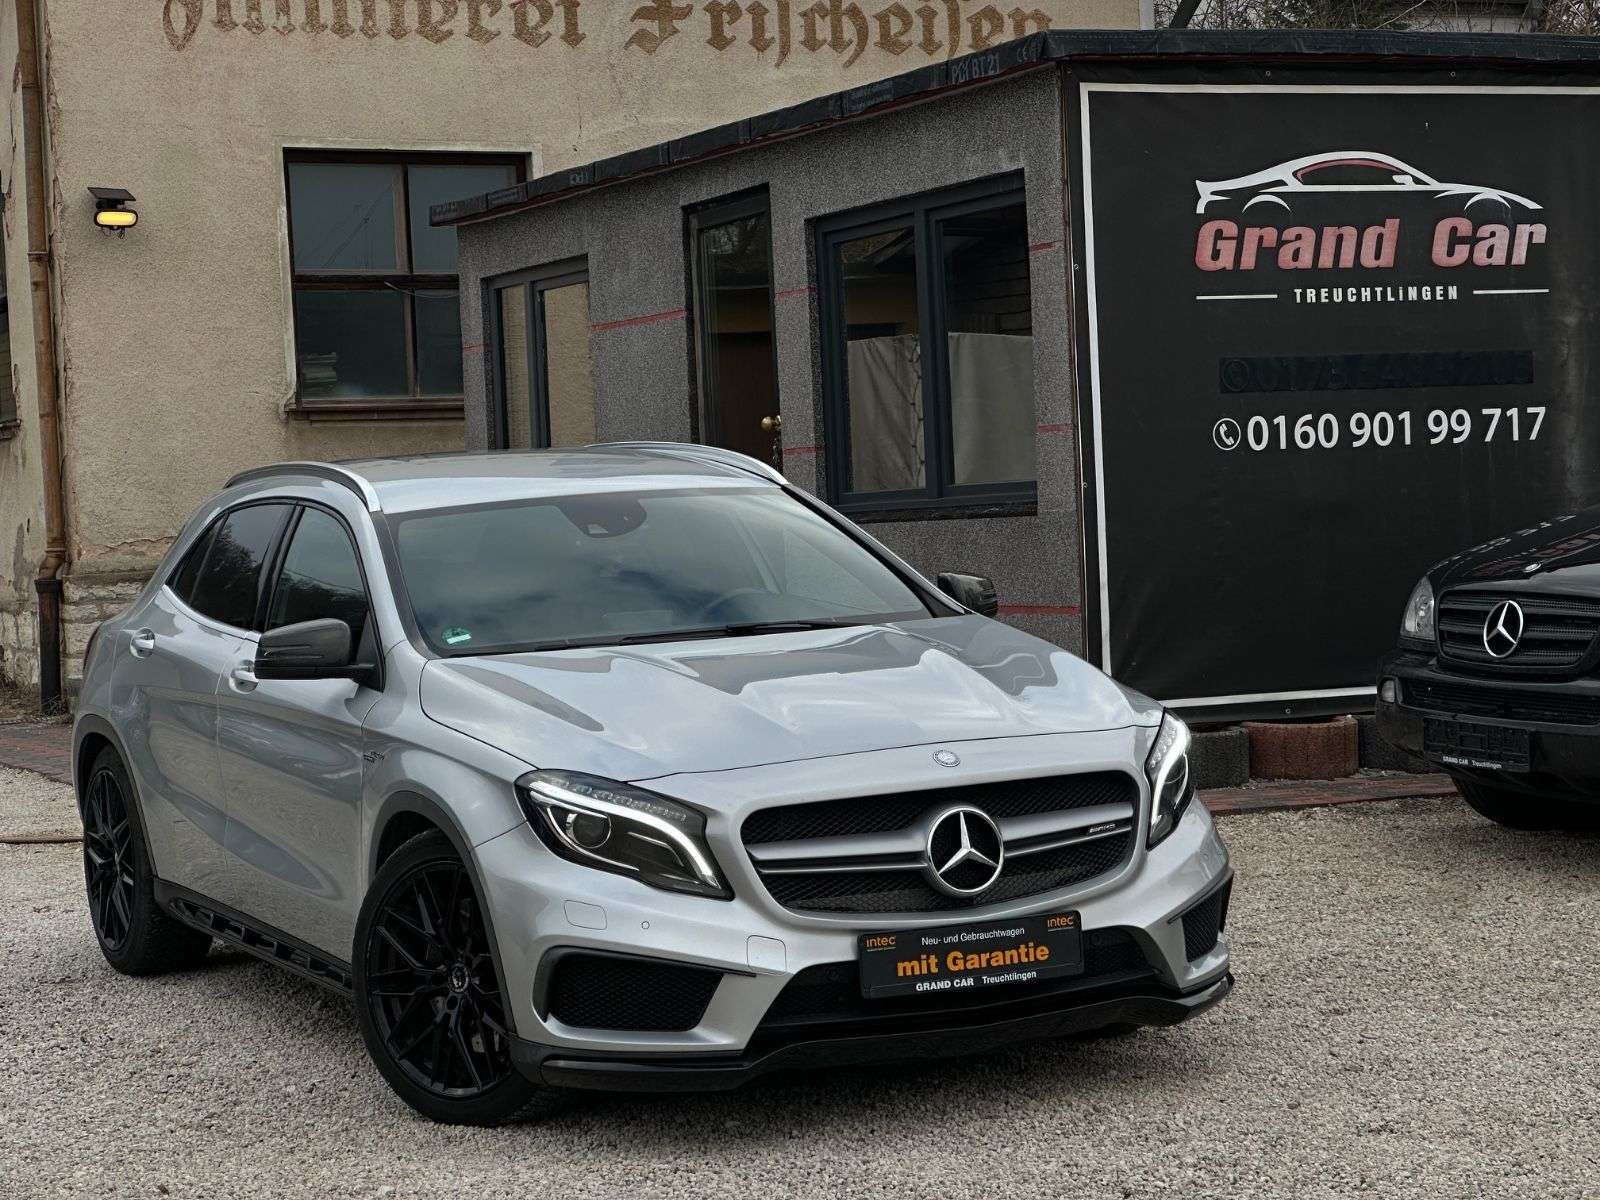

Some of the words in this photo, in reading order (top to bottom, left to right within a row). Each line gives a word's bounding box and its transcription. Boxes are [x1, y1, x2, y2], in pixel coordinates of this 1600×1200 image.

[1195, 218, 1400, 271] Grand
[1431, 215, 1547, 267] Car
[1294, 285, 1458, 304] TREUCHTLINGEN
[1247, 413, 1340, 452] 0160
[1350, 410, 1412, 448] 901
[1427, 408, 1472, 445] 99
[1481, 406, 1546, 443] 717
[1047, 916, 1074, 928] intec
[866, 936, 896, 947] intec
[921, 936, 941, 946] Neu-
[943, 933, 959, 944] und
[960, 927, 1025, 942] Gebrauchtwagen
[896, 954, 939, 977] mit
[946, 942, 1050, 972] Garantie
[915, 979, 952, 992] GRAND
[953, 977, 975, 988] CAR
[982, 970, 1037, 985] Treuchtlingen
